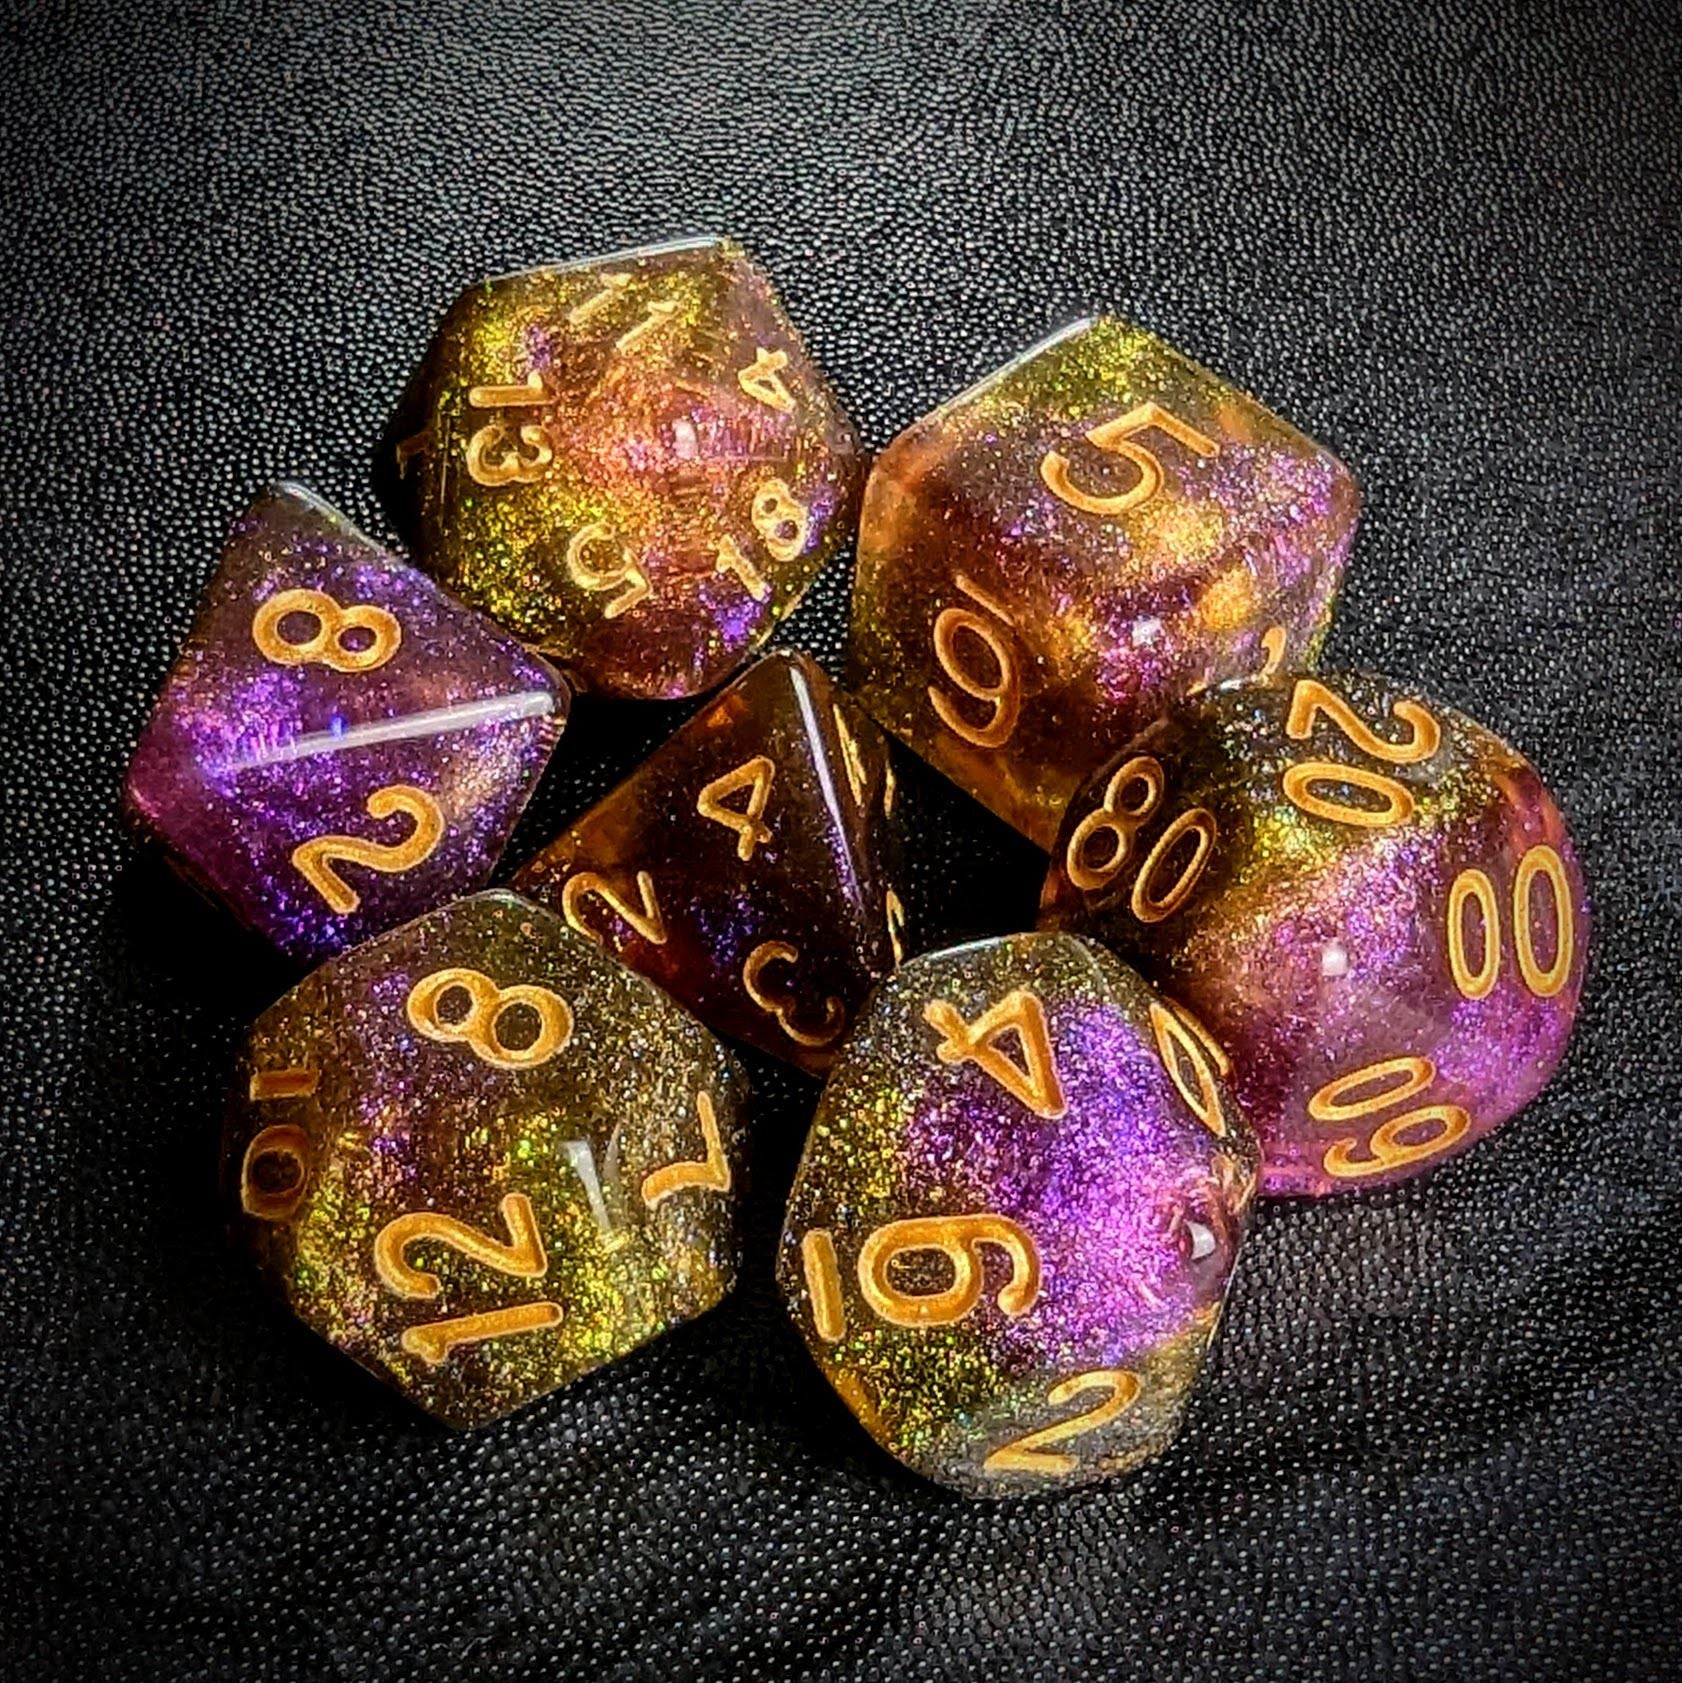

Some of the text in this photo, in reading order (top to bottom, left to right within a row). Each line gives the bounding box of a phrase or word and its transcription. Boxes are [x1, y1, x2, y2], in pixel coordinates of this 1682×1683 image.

[467, 371, 553, 487] 13
[737, 346, 796, 414] 4
[1039, 402, 1221, 516] 5
[566, 521, 655, 620] 5
[715, 478, 808, 602] 18
[252, 588, 402, 673] 8
[697, 755, 777, 862] 4
[1282, 679, 1441, 828] 20
[291, 783, 445, 914] 2
[1066, 756, 1216, 924] 80
[562, 870, 668, 946] 2
[1447, 844, 1574, 1002] 00
[406, 967, 575, 1070] 8
[742, 940, 846, 1048] 3
[922, 989, 1067, 1120] 4
[240, 1068, 321, 1221] 10
[640, 1091, 732, 1209] 7
[374, 1192, 565, 1364] 12
[983, 1369, 1143, 1475] 2
